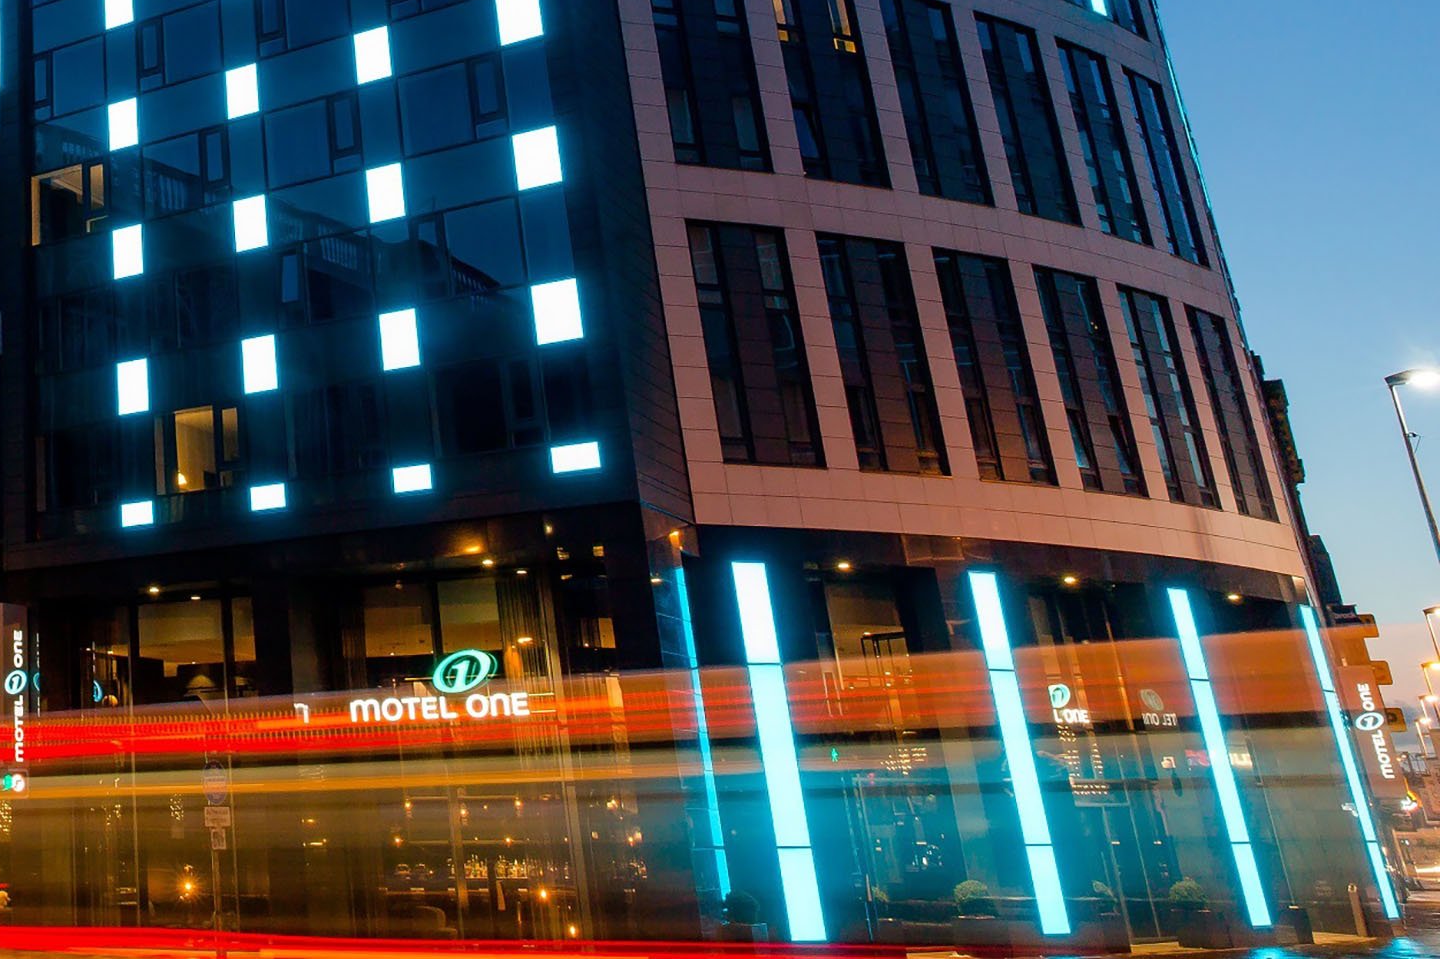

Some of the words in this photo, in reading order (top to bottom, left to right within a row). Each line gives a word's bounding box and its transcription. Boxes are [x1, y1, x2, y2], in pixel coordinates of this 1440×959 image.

[13, 630, 23, 668] ONE
[349, 696, 458, 723] MOTEL
[465, 692, 531, 719] ONE
[1357, 683, 1375, 712] ONE
[14, 695, 24, 762] MOTEL
[1371, 729, 1396, 779] MOTEL
